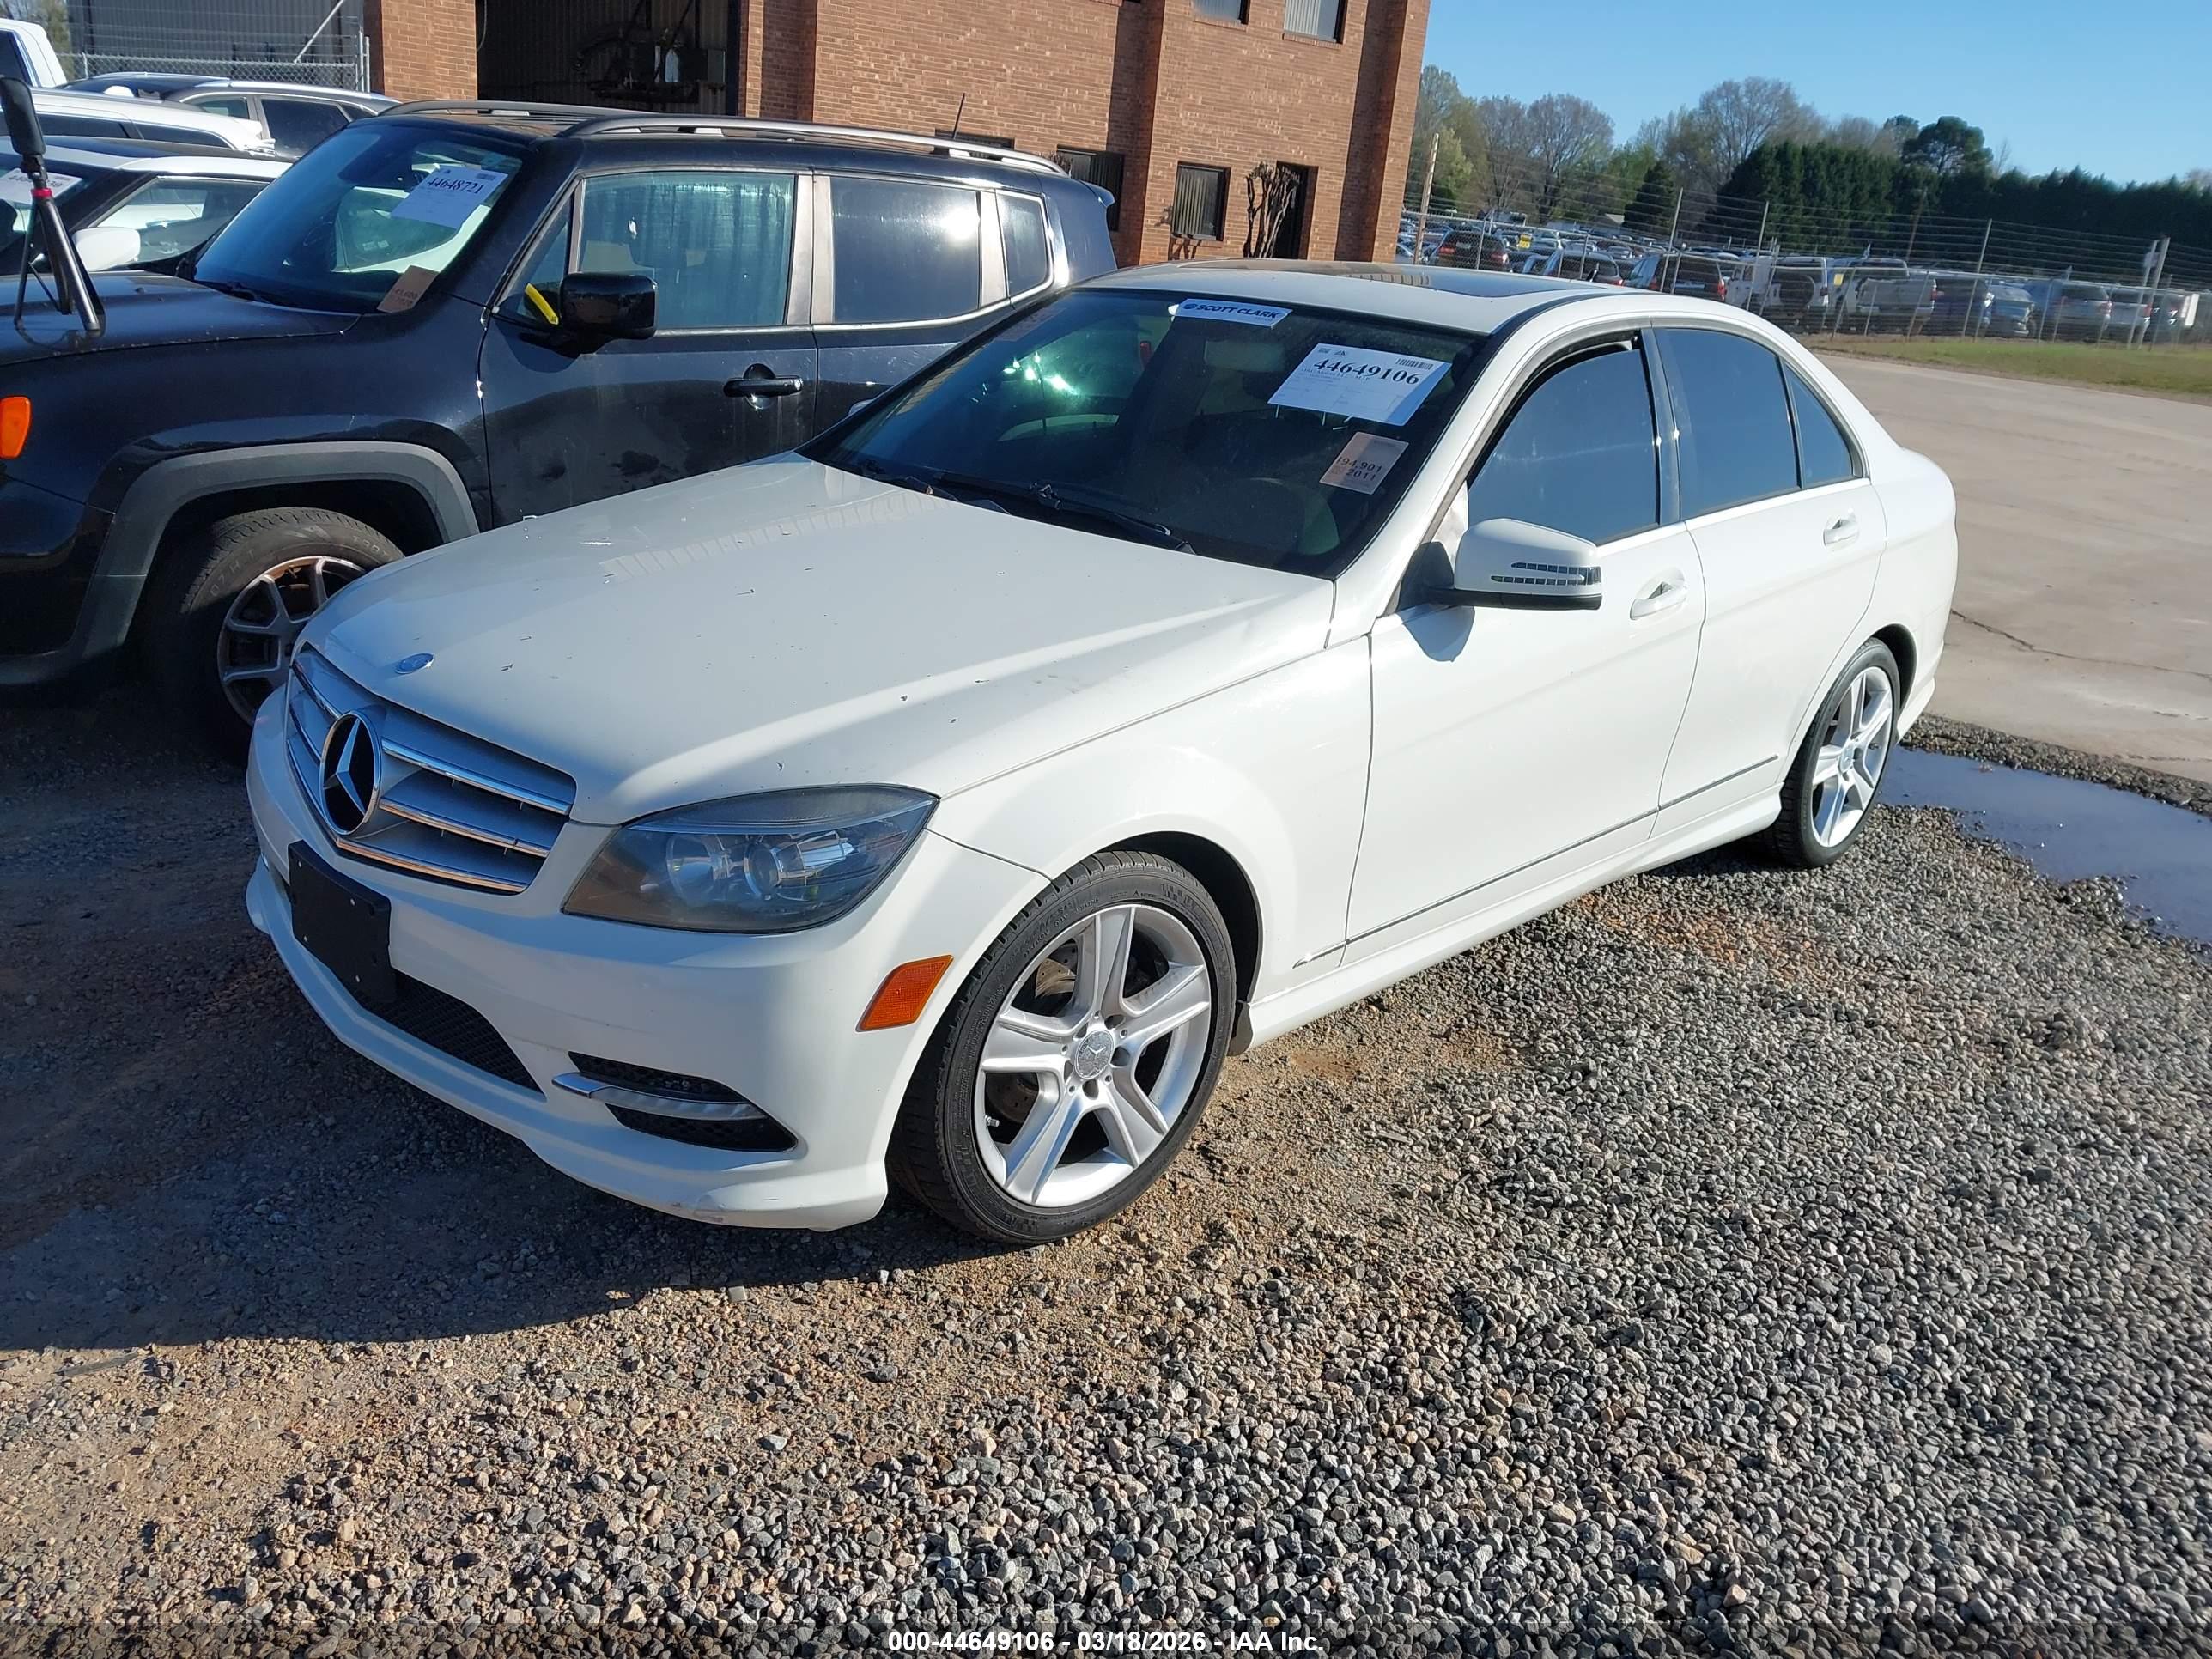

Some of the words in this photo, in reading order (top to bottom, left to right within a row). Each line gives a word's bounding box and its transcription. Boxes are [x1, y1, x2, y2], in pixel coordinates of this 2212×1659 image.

[427, 177, 485, 194] 44648721
[1196, 304, 1237, 315] SCOTT
[1236, 308, 1279, 319] CLARK
[1314, 357, 1423, 385] 44649106
[1335, 456, 1382, 473] 194,901
[1346, 468, 1376, 481] 2011
